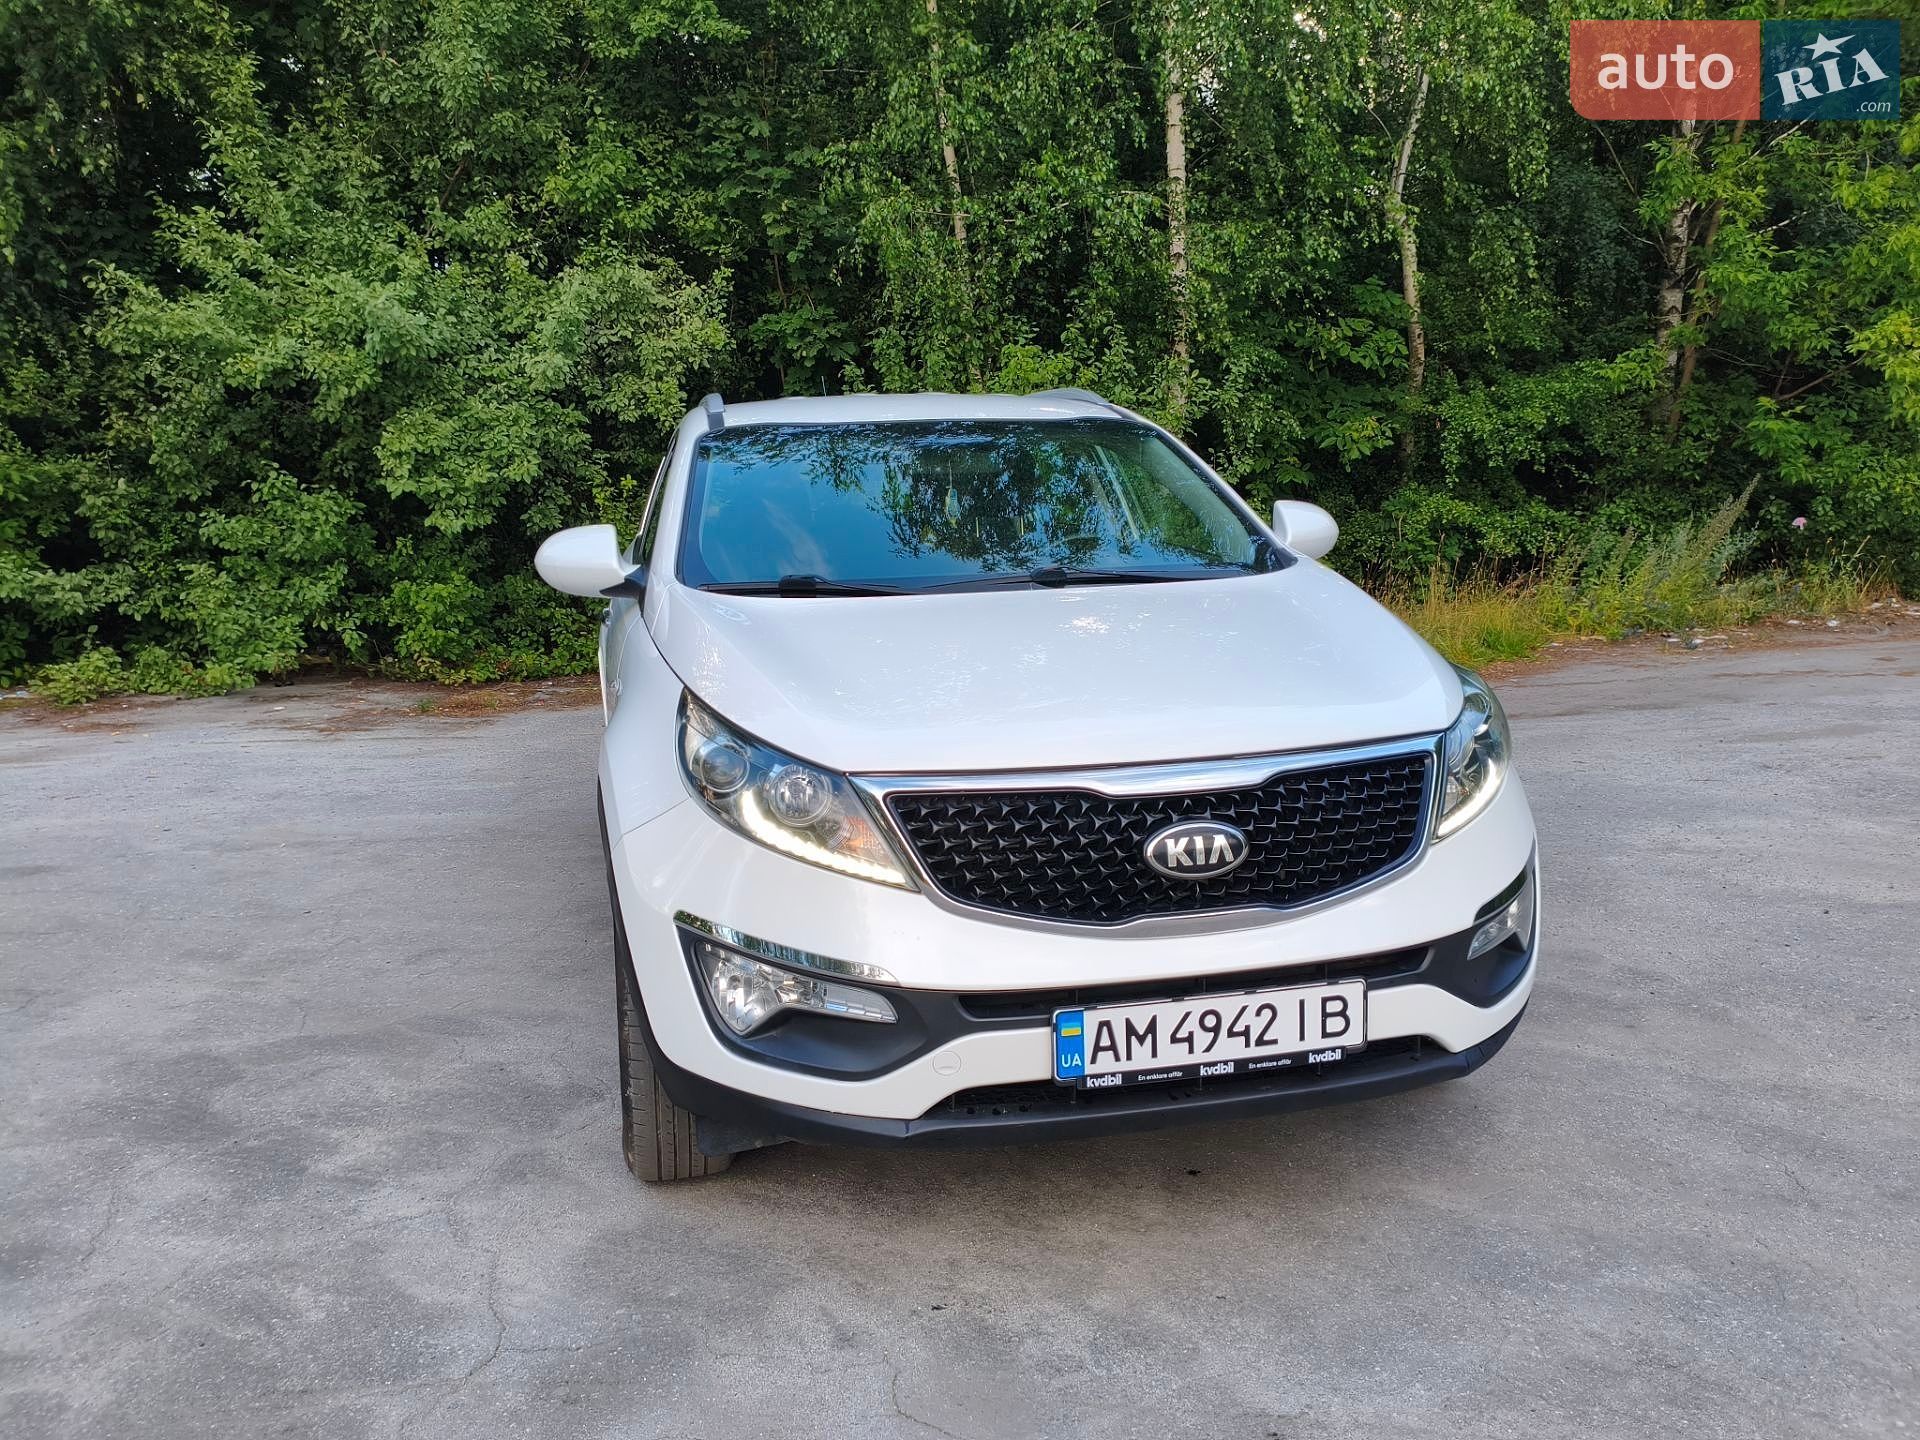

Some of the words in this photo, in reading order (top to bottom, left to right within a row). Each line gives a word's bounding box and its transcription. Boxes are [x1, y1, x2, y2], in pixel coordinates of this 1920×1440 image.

[1165, 834, 1234, 867] KIA
[1090, 1014, 1158, 1064] AM
[1169, 1003, 1279, 1055] 4942
[1298, 994, 1350, 1042] IB
[1061, 1053, 1082, 1067] UA
[1086, 1073, 1122, 1088] kvdbil
[1200, 1062, 1234, 1076] kvdbil
[1308, 1049, 1341, 1064] kvdbil
